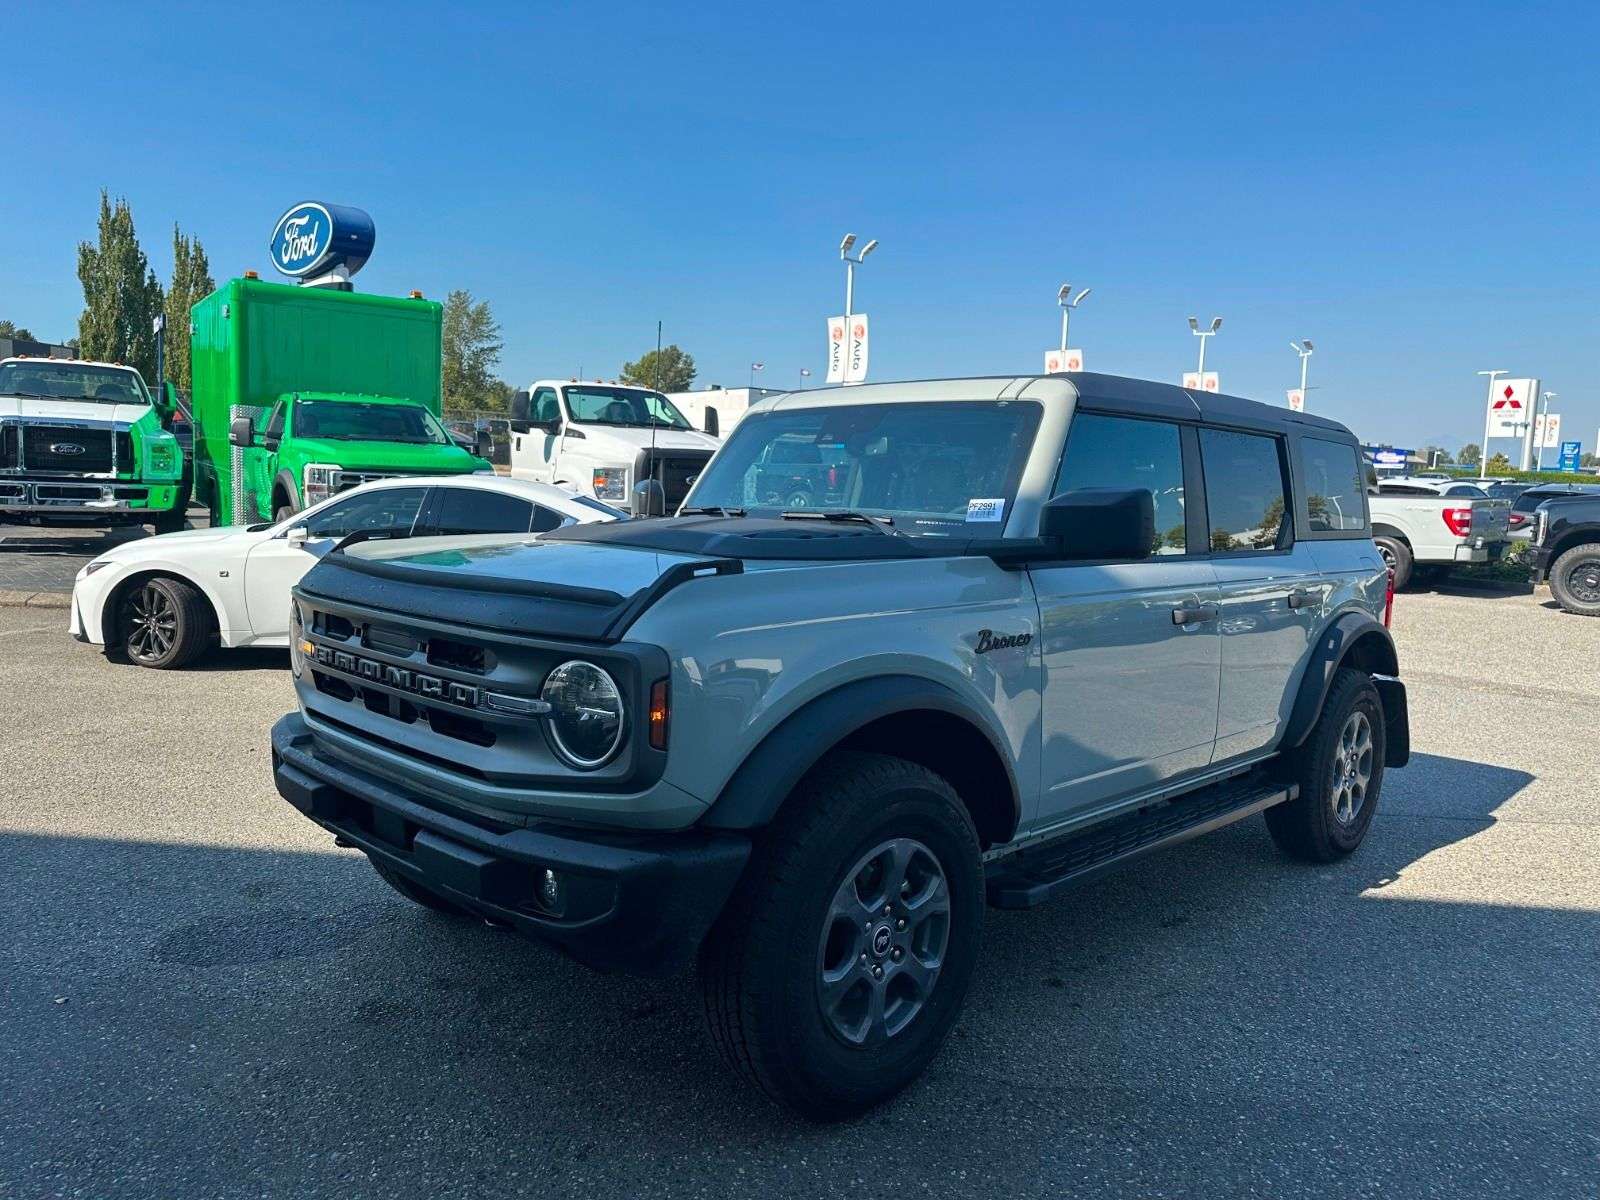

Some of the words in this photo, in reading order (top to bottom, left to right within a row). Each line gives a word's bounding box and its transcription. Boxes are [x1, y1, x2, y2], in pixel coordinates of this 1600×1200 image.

[282, 215, 319, 264] Ford
[832, 342, 840, 372] Auto
[852, 339, 862, 370] Auto
[968, 502, 996, 511] PF2991
[975, 629, 1033, 654] Bronco
[316, 645, 479, 706] BRONCO
